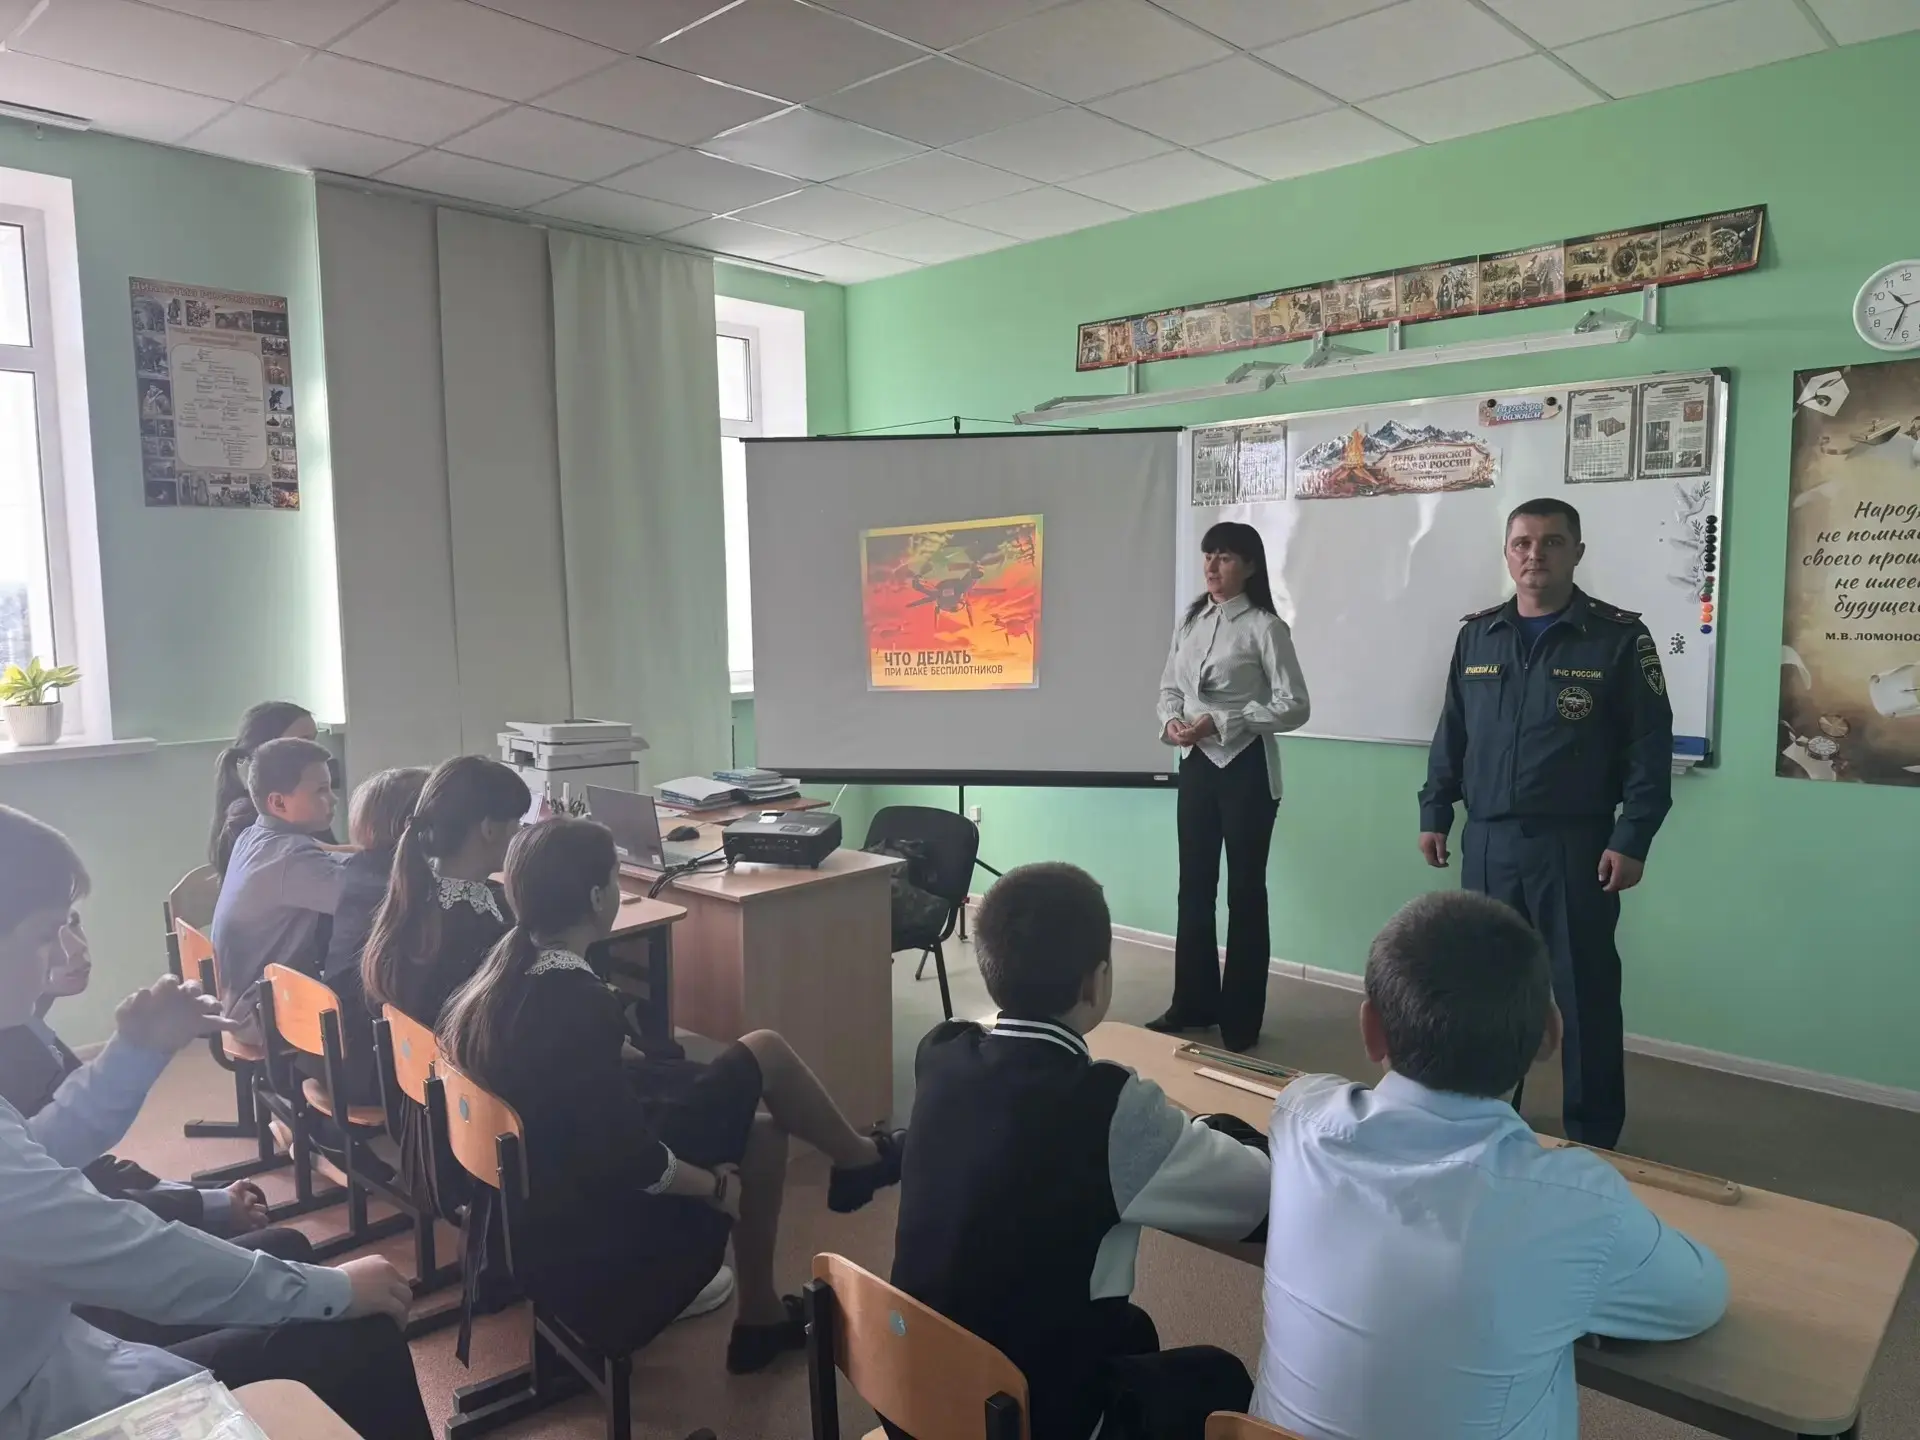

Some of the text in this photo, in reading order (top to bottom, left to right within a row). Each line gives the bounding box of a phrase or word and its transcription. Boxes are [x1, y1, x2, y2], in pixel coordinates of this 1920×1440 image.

[1900, 272, 1912, 281] 12
[1884, 280, 1894, 288] 11
[1873, 292, 1885, 301] 10
[1868, 306, 1876, 317] 9
[1873, 319, 1881, 328] 8
[1885, 327, 1893, 336] 7
[1901, 330, 1909, 339] 6
[1419, 448, 1472, 460] ВОИНСКОЙ
[1429, 458, 1471, 469] РОССИИ
[1816, 530, 1841, 543] не
[1802, 547, 1863, 566] своего
[1835, 577, 1920, 589] не имее
[1834, 594, 1920, 619] будущег
[1825, 632, 1920, 642] М.В. ЛОМОНОС
[884, 649, 972, 667] ЧТО ДЕЛАТЬ
[884, 664, 1003, 677] ПРИ АТАКЕ БЕСПИЛОТНИКОВ
[1552, 668, 1601, 678] МЧС РОССИИ
